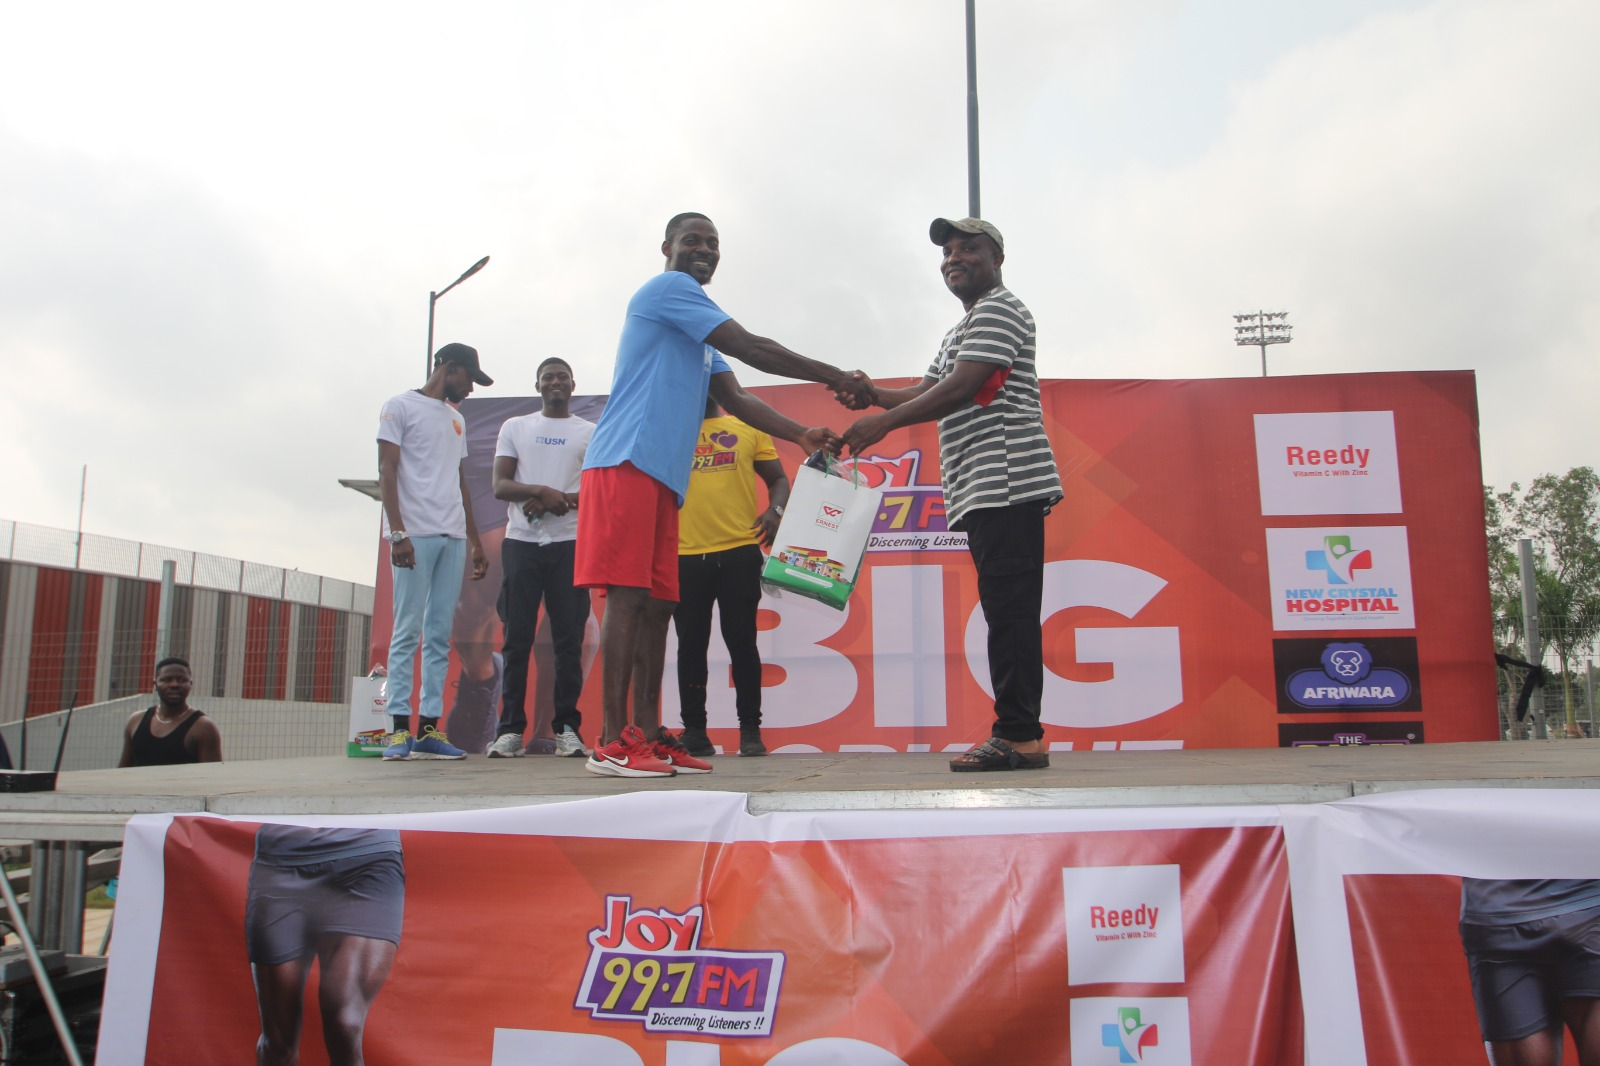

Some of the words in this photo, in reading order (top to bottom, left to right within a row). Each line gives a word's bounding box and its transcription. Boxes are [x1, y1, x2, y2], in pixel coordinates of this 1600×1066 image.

[544, 437, 566, 446] USN
[714, 453, 733, 465] FM
[1286, 444, 1370, 468] Reedy
[842, 457, 915, 489] OY
[815, 518, 839, 530] ERNEST
[869, 537, 930, 549] Discerning
[933, 536, 969, 547] Listen
[1285, 588, 1324, 599] NEW
[1327, 587, 1398, 598] CRYSTAL
[1286, 598, 1399, 613] HOSPITAL
[1303, 686, 1396, 700] AFRIWARA
[1338, 735, 1363, 744] THE
[1090, 903, 1159, 930] Reedy
[1121, 932, 1126, 940] C
[1127, 931, 1141, 939] With
[601, 957, 695, 1011] 99.7
[697, 964, 759, 1007] FM
[651, 1012, 707, 1031] Discerning
[709, 1014, 751, 1030] Listeners
